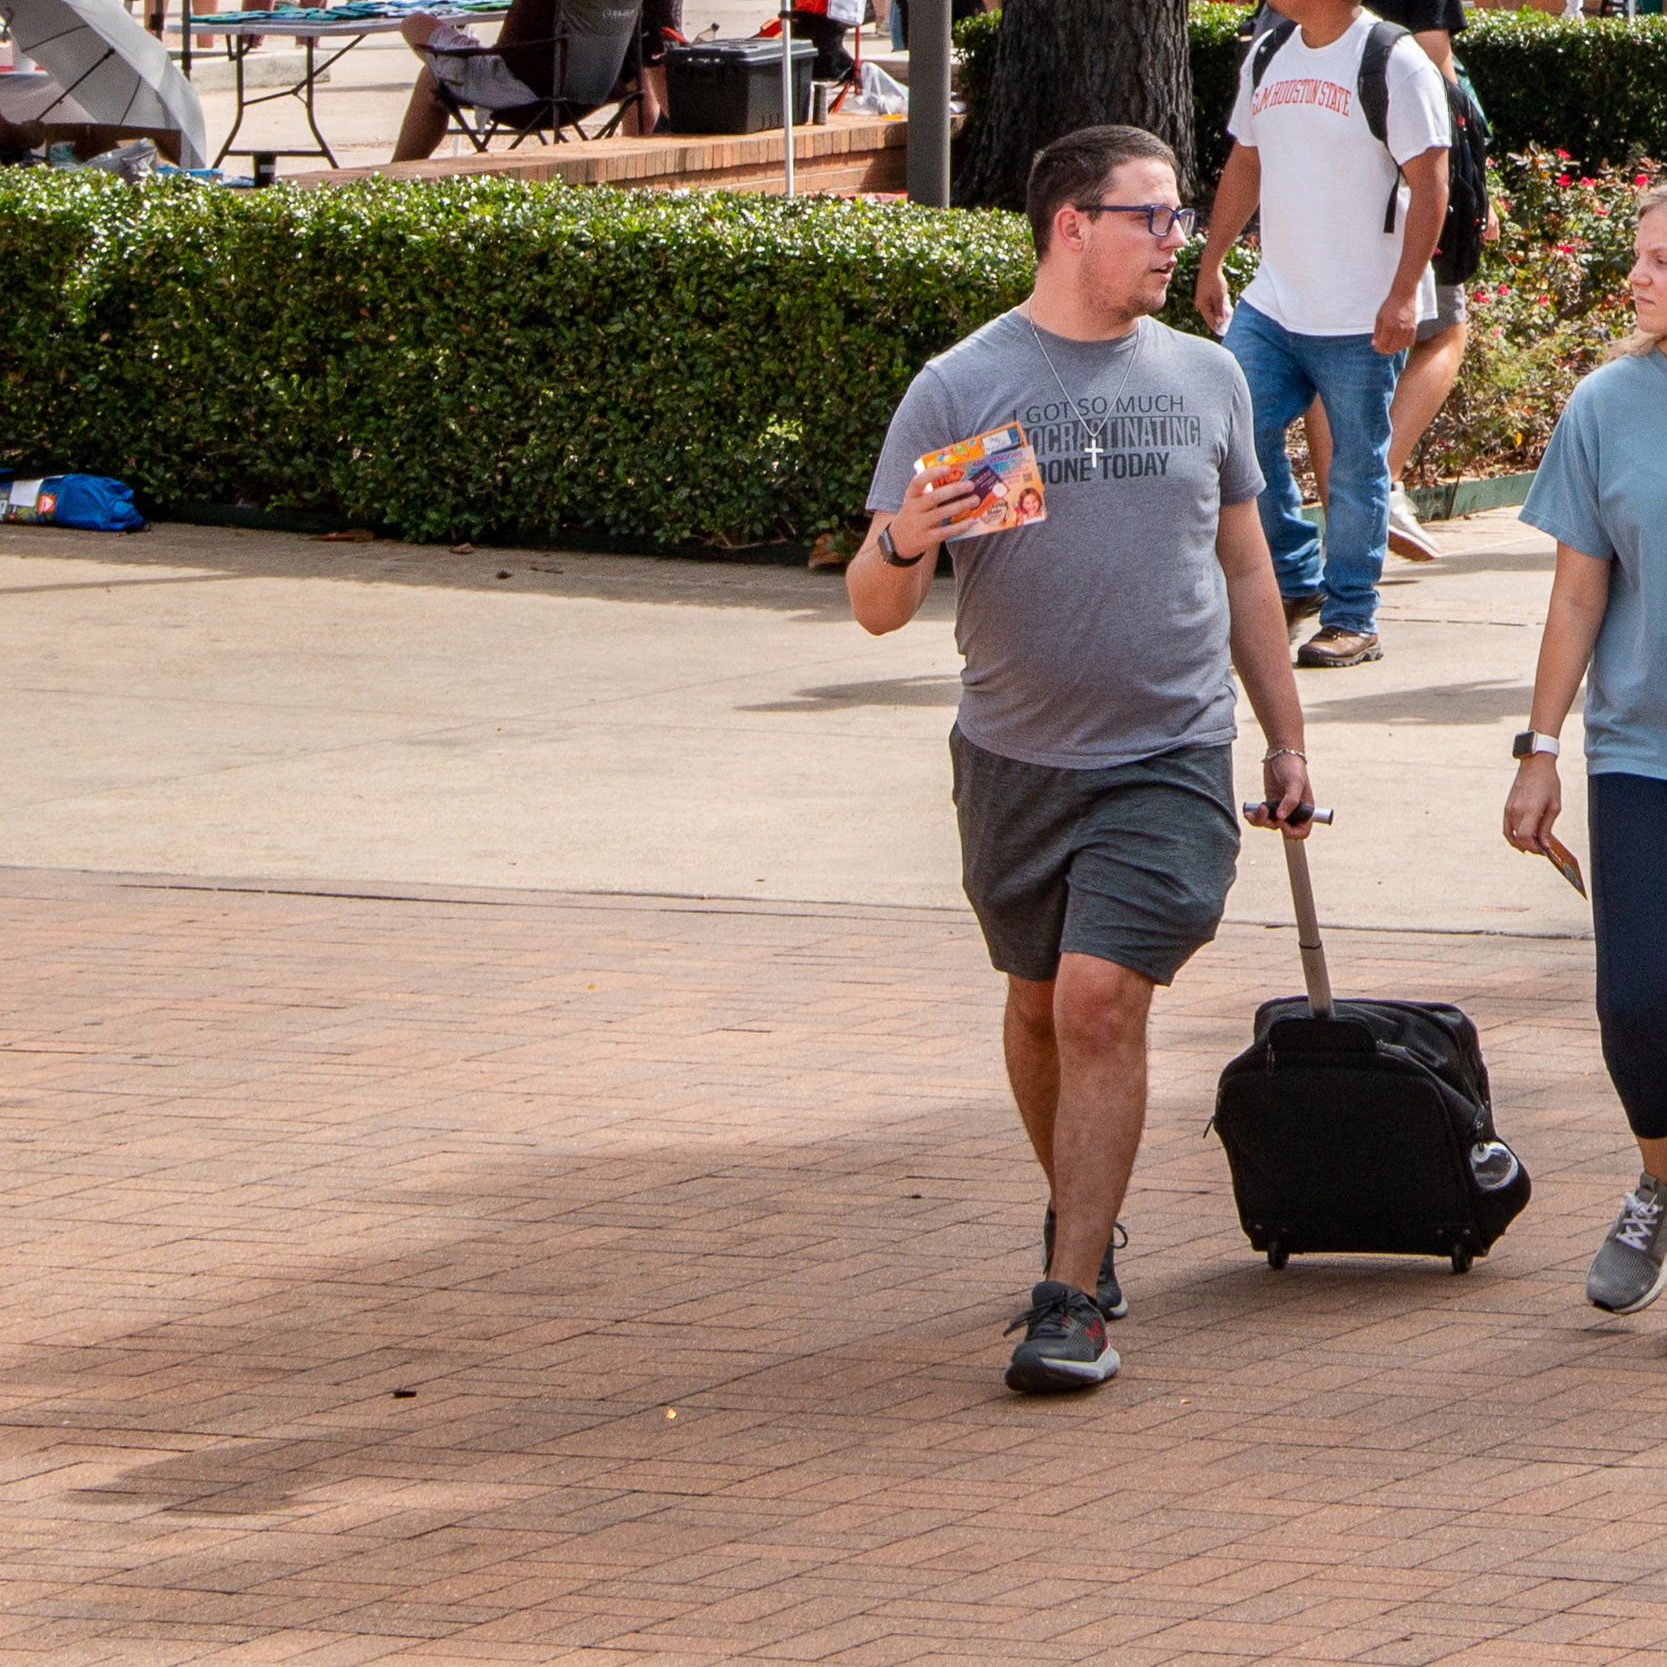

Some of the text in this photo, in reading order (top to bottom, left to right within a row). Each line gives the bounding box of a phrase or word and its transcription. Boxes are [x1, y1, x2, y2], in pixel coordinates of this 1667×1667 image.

[1269, 78, 1321, 108] HOUSTON
[1317, 79, 1352, 117] STATE
[1026, 401, 1071, 424] GOT
[1077, 396, 1108, 417] SO
[1115, 394, 1185, 415] MUCH
[1037, 456, 1092, 485] DONE
[1099, 451, 1170, 481] TODAY
